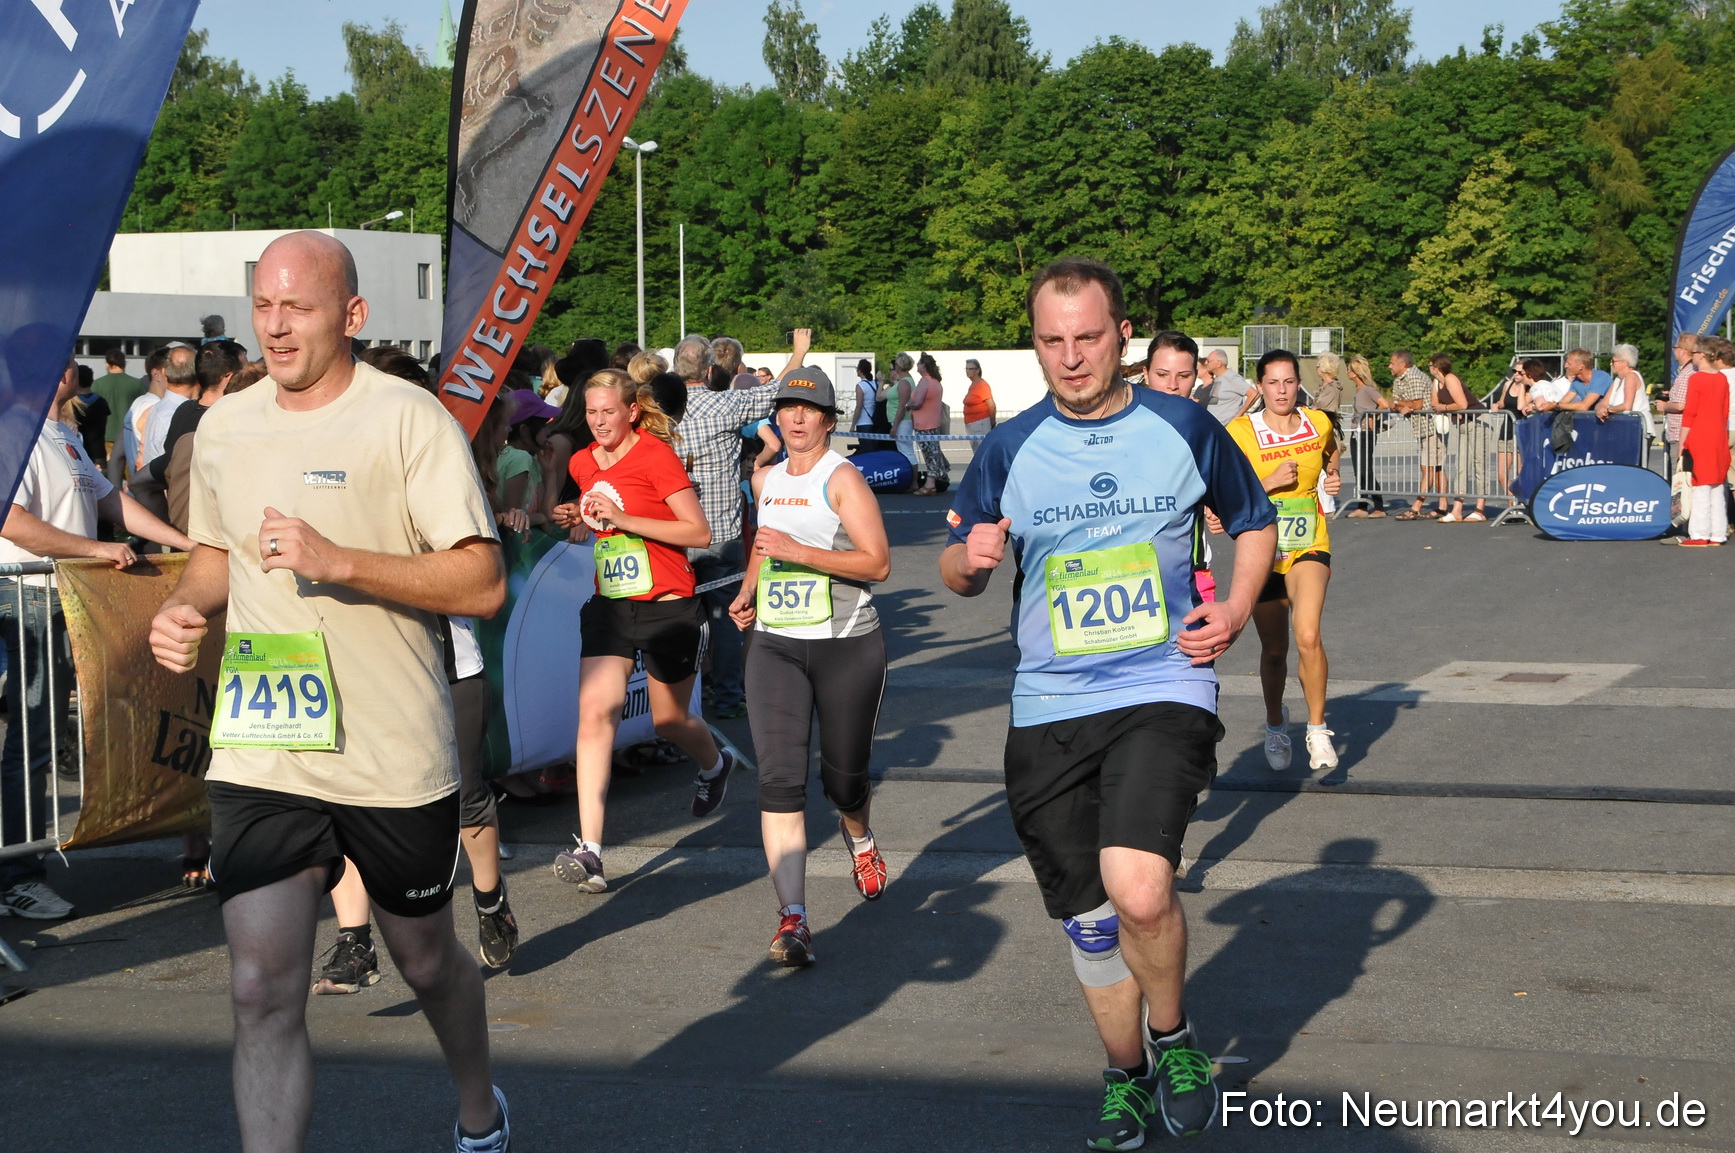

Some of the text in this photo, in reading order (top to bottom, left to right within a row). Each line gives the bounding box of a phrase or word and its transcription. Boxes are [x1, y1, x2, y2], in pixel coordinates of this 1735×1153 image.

[443, 0, 671, 403] WECHSELSZENE
[1261, 441, 1322, 462] MAX BÖGL
[303, 471, 347, 485] VETTER
[773, 497, 812, 507] KLEBL
[1569, 496, 1659, 516] Fischer
[1033, 496, 1177, 526] SCHABMÜLLER
[1577, 515, 1652, 525] AUTOMOBILE
[1085, 525, 1122, 538] TEAM
[604, 555, 639, 582] 449
[1059, 567, 1099, 580] firmenlauf
[768, 580, 817, 609] 557
[1053, 578, 1160, 630] 1204
[1084, 625, 1135, 637] Christian Kobras
[1084, 636, 1118, 645] Schabmüller
[1119, 633, 1137, 641] GmbH
[233, 652, 266, 662] firmenlauf
[225, 674, 328, 719] 1419
[419, 884, 441, 898] JAKO
